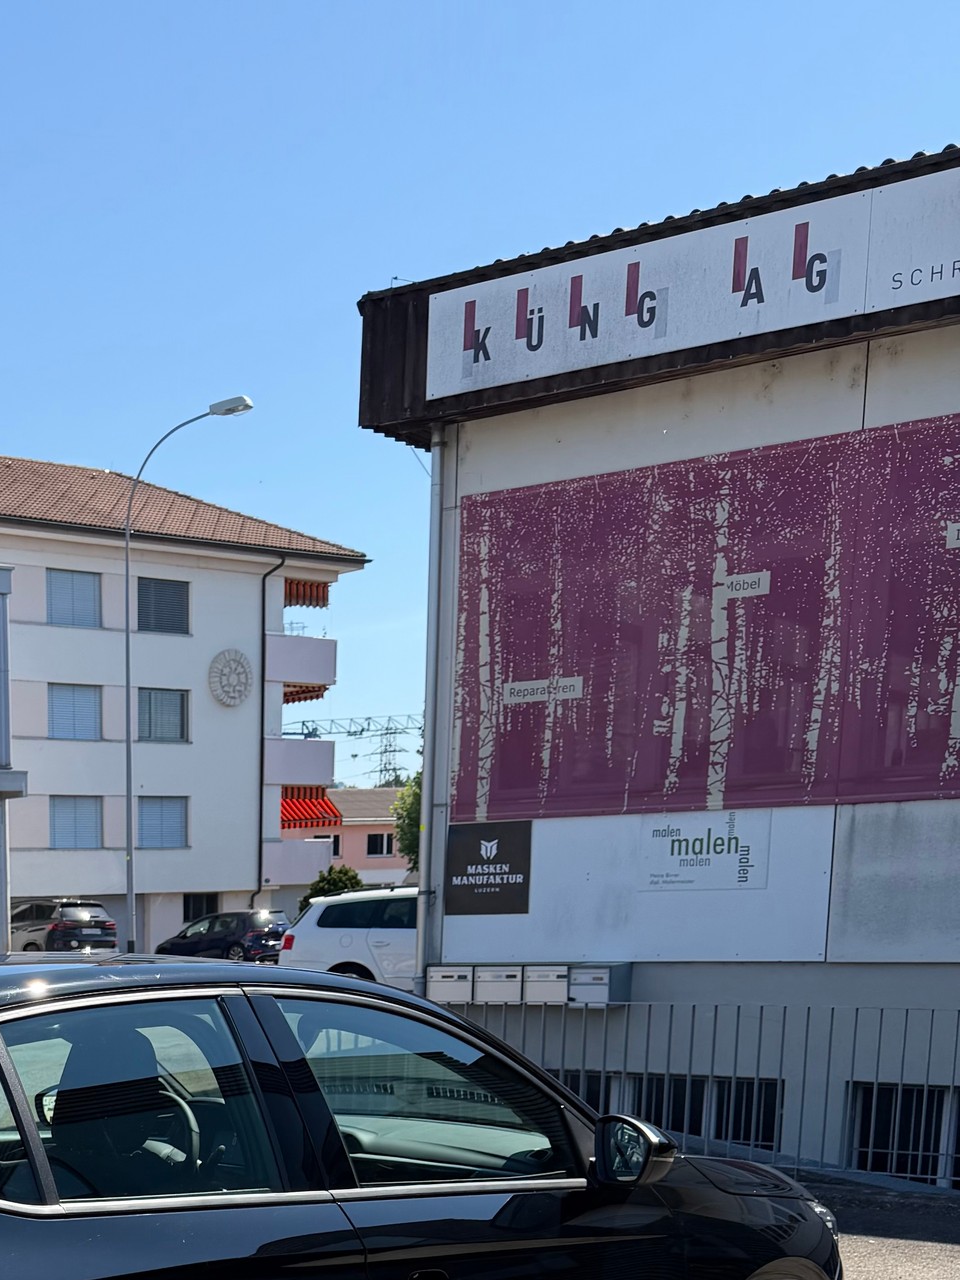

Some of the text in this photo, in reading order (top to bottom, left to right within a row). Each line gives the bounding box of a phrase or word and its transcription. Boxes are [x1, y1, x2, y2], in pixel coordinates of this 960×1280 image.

[472, 252, 960, 364] KÜNG AG SCHR
[509, 683, 576, 699] Reparatren
[652, 824, 681, 838] malen
[725, 811, 736, 836] malen
[670, 827, 740, 856] malen
[466, 863, 510, 874] MASKEN
[679, 854, 711, 867] malen
[737, 845, 755, 883] malen
[452, 874, 524, 886] MANUFAKTUR
